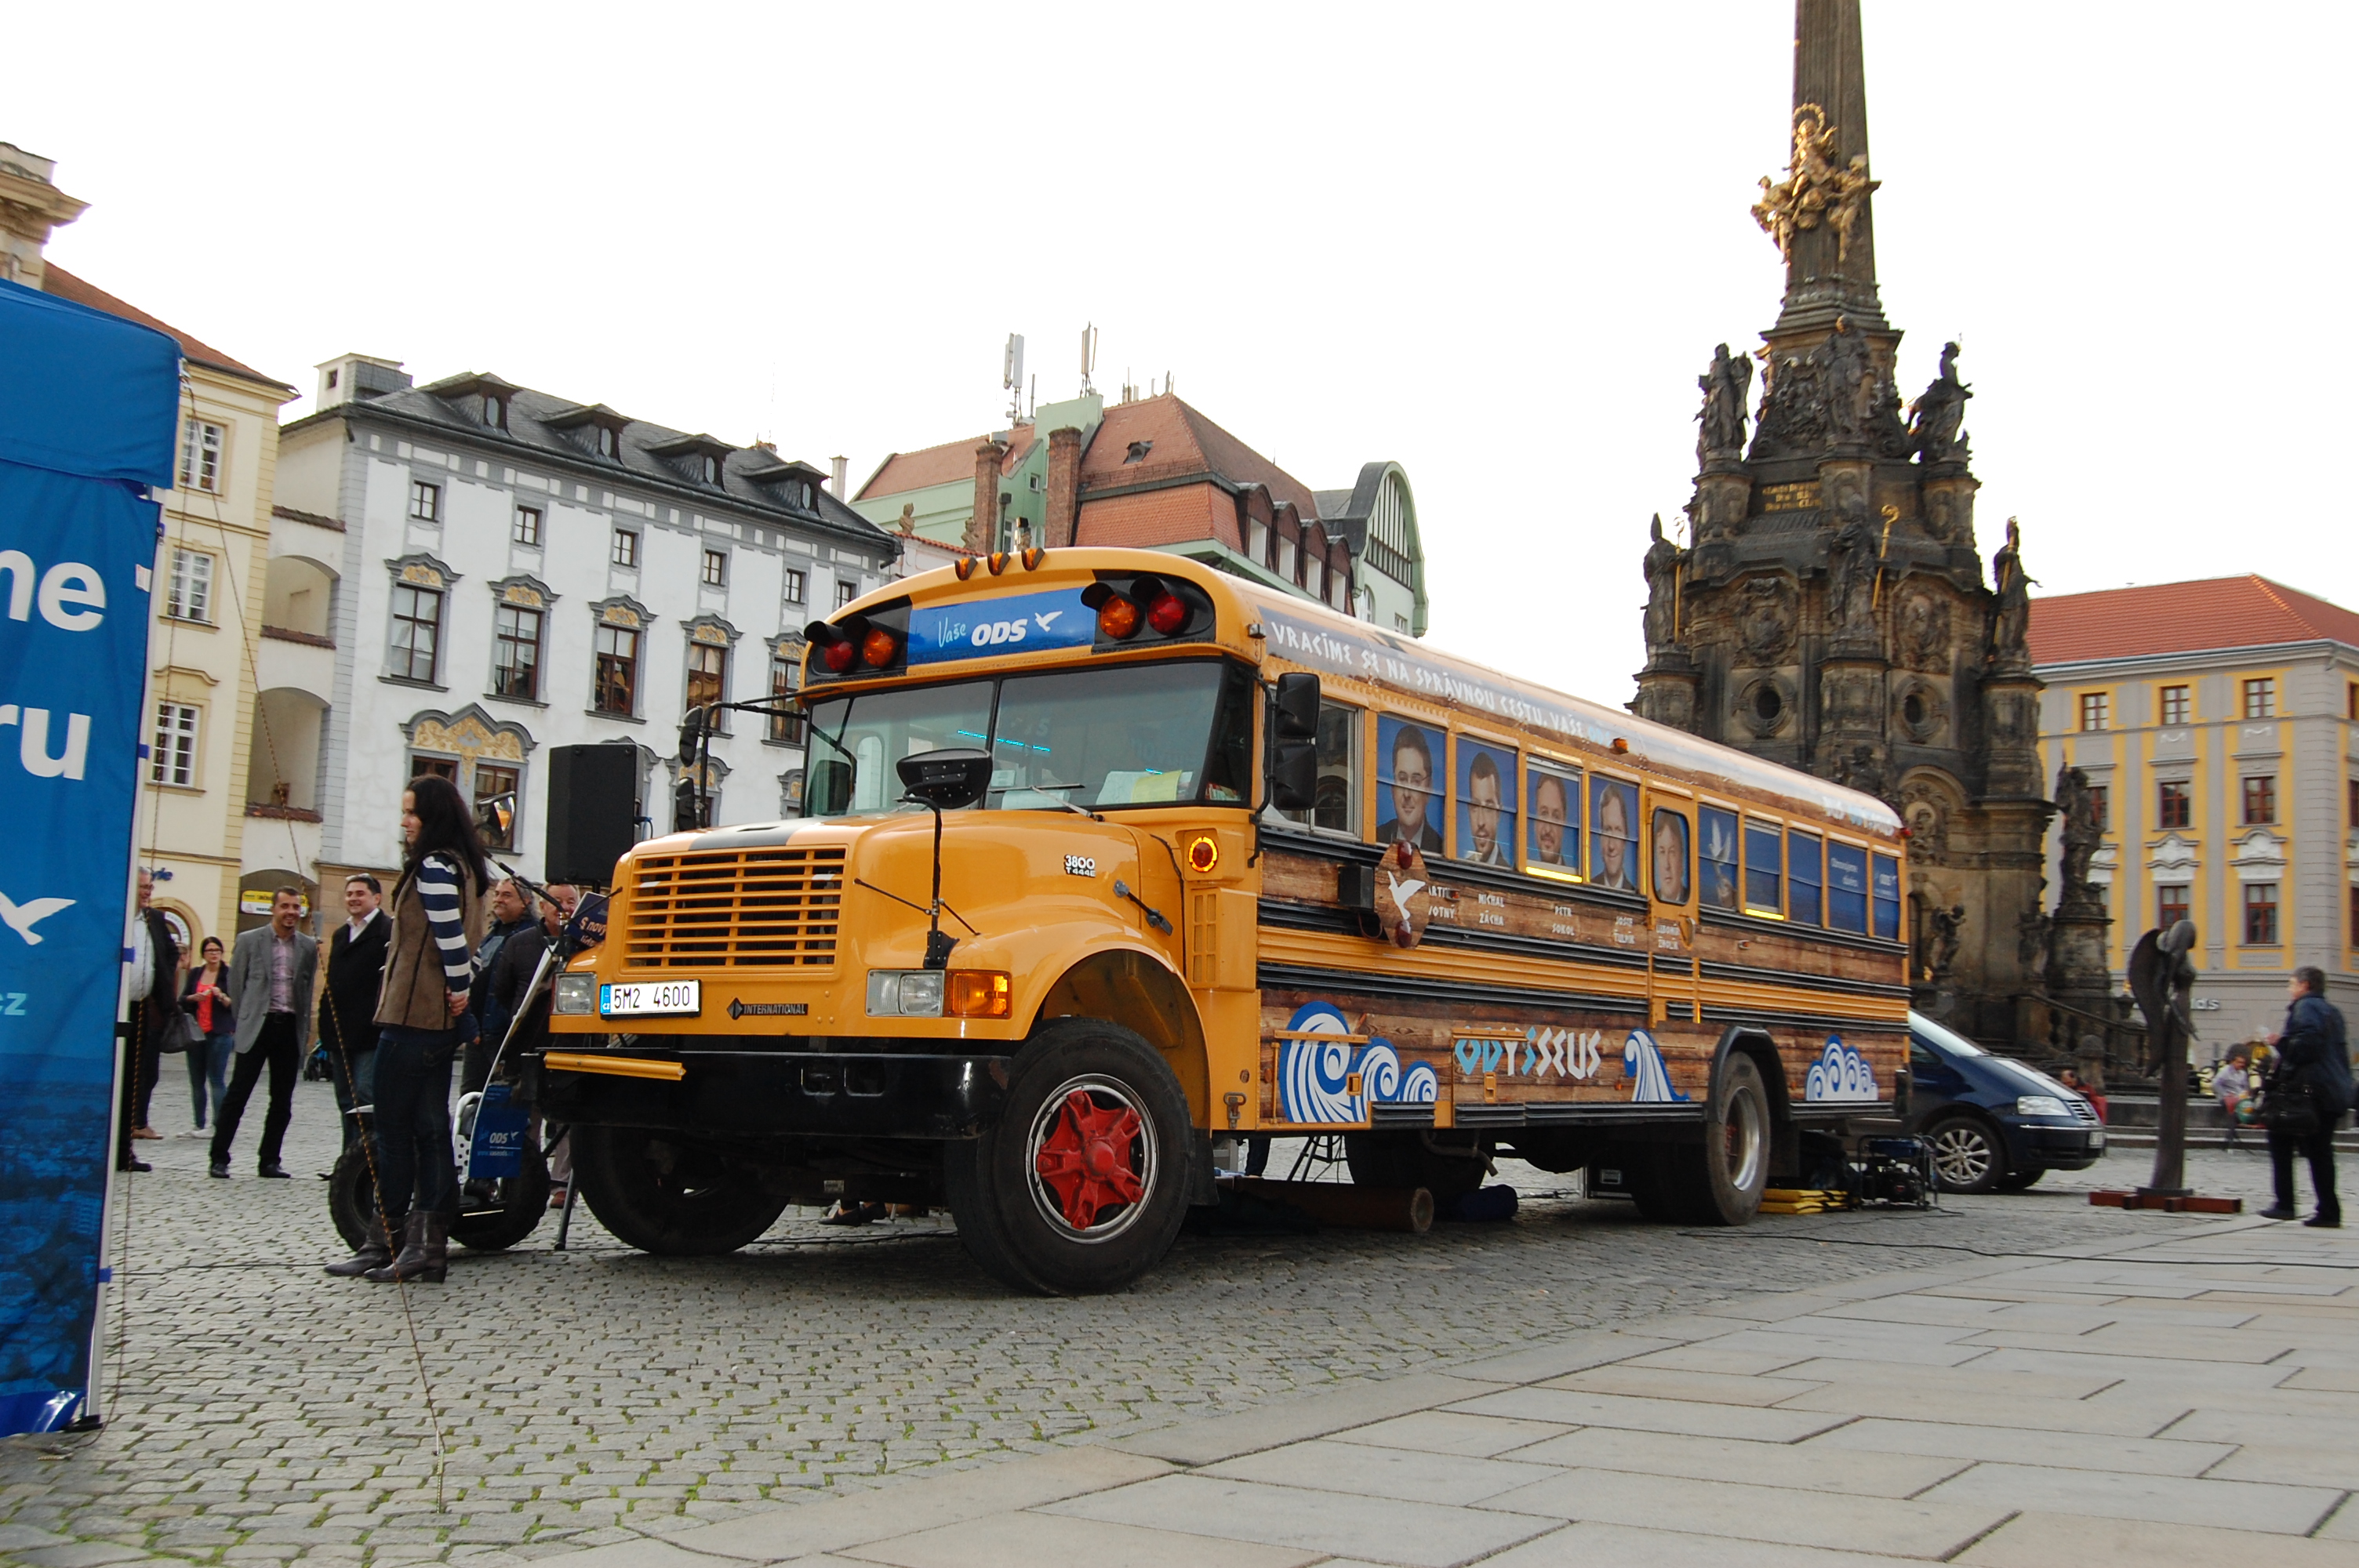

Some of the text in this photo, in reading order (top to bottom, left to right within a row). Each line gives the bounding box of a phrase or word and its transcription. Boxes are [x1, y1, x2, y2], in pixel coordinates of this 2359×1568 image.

[938, 617, 1028, 648] Vaše ODS
[1271, 622, 1353, 665] VRACÍME
[1361, 649, 1379, 673] SE
[1386, 658, 1410, 683] NA
[1415, 666, 1496, 710] SPRÁVNOU
[1065, 855, 1095, 870] 3800
[1478, 893, 1505, 908] MICHAL
[579, 916, 589, 931] S
[614, 985, 690, 1010] 5M2 4600
[743, 1004, 805, 1014] INTERNATIONAL
[1455, 1025, 1601, 1080] ODYSSEUS
[489, 1132, 508, 1144] ODS
